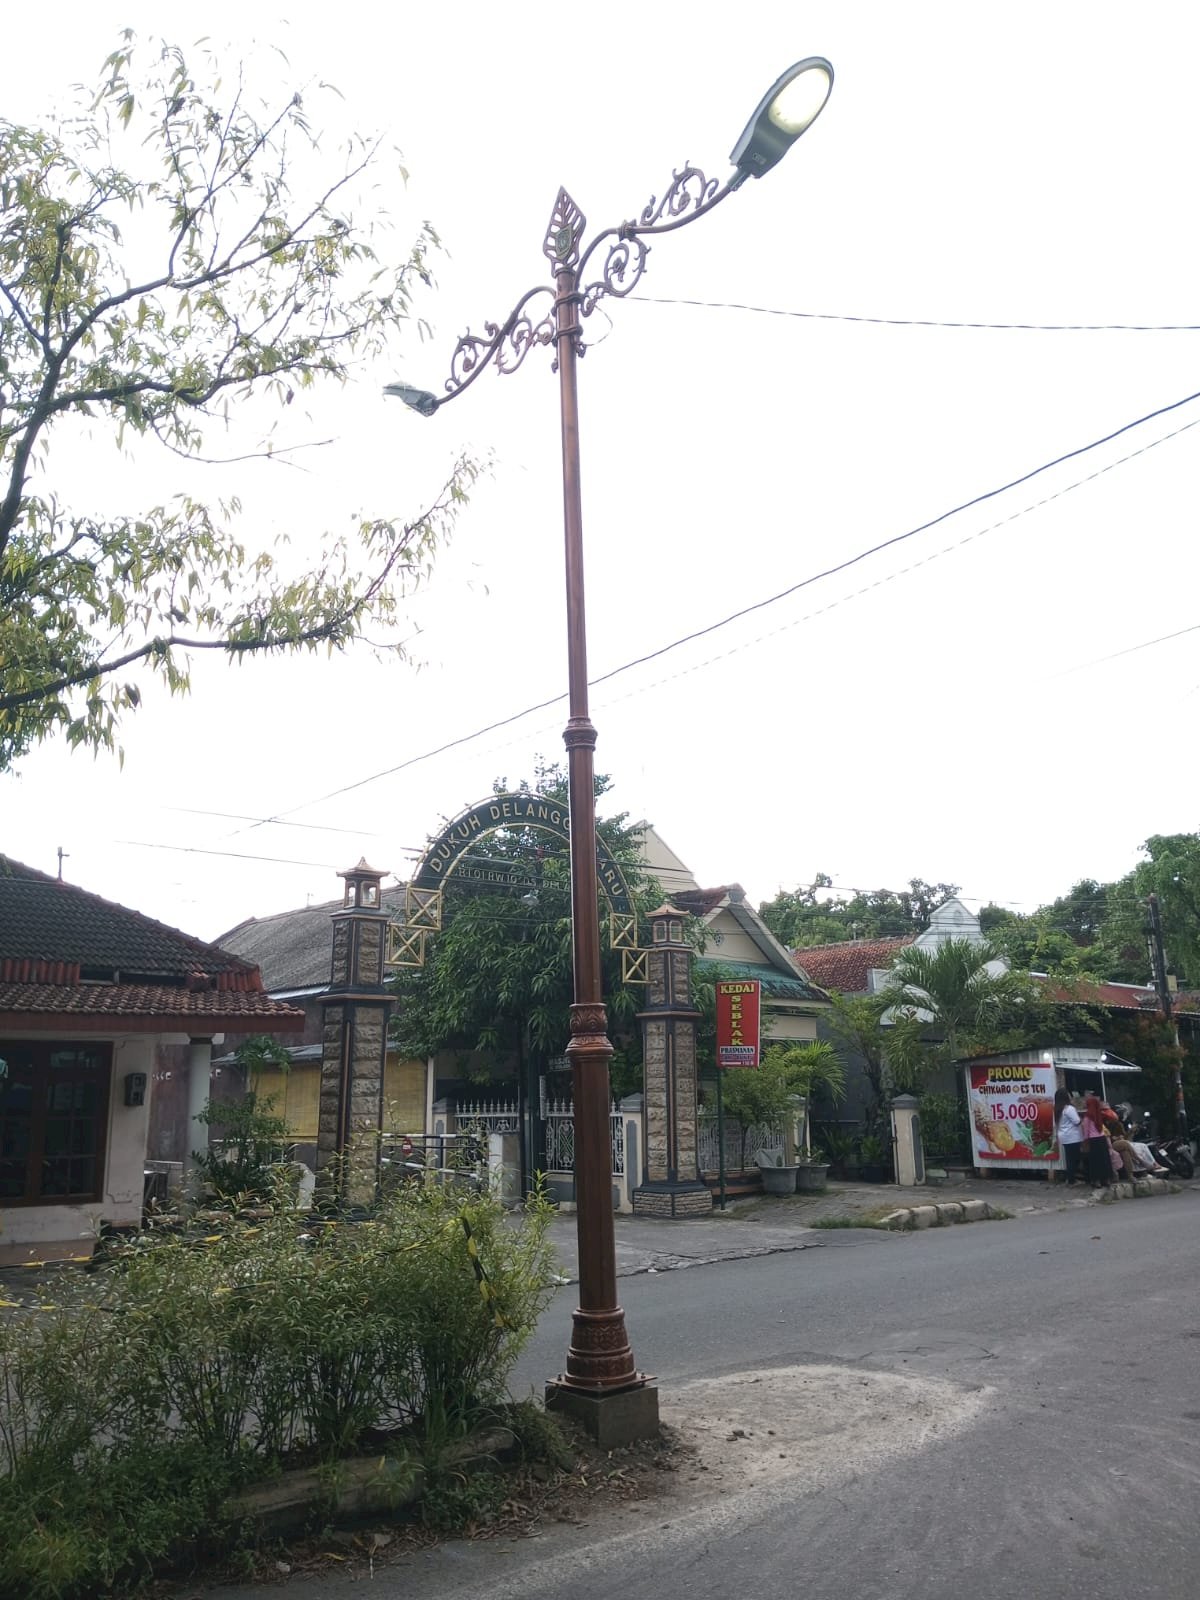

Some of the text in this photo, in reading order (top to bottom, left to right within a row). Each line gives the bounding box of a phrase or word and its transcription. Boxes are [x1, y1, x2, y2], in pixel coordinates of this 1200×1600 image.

[430, 815, 480, 872] DUKUH
[490, 802, 570, 831] DELANGG
[720, 983, 755, 994] KEDAI
[731, 995, 744, 1046] SEBLAK
[988, 1067, 1033, 1079] PROMO
[1020, 1085, 1029, 1093] ES
[990, 1103, 1037, 1120] 15.000
